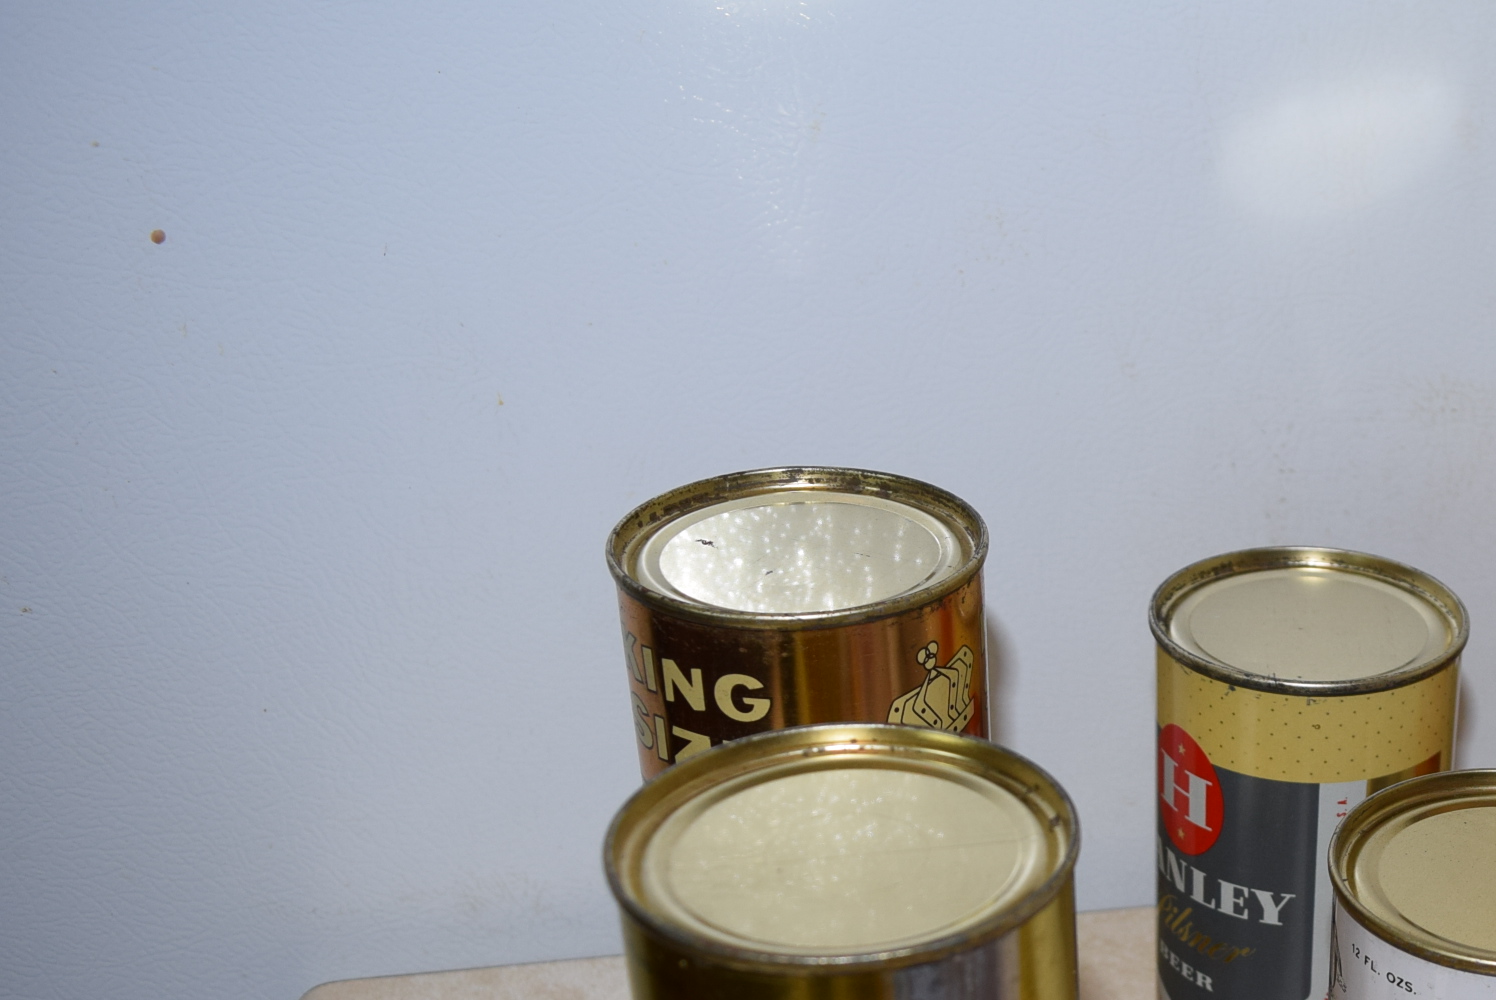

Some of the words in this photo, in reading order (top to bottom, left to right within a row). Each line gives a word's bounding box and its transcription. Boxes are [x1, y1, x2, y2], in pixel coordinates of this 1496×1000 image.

[621, 630, 772, 723] KING
[631, 690, 736, 765] SIZ
[1161, 748, 1213, 832] H
[1351, 943, 1361, 956] 12
[1363, 955, 1381, 976] FL.
[1386, 971, 1417, 995] OZS.
